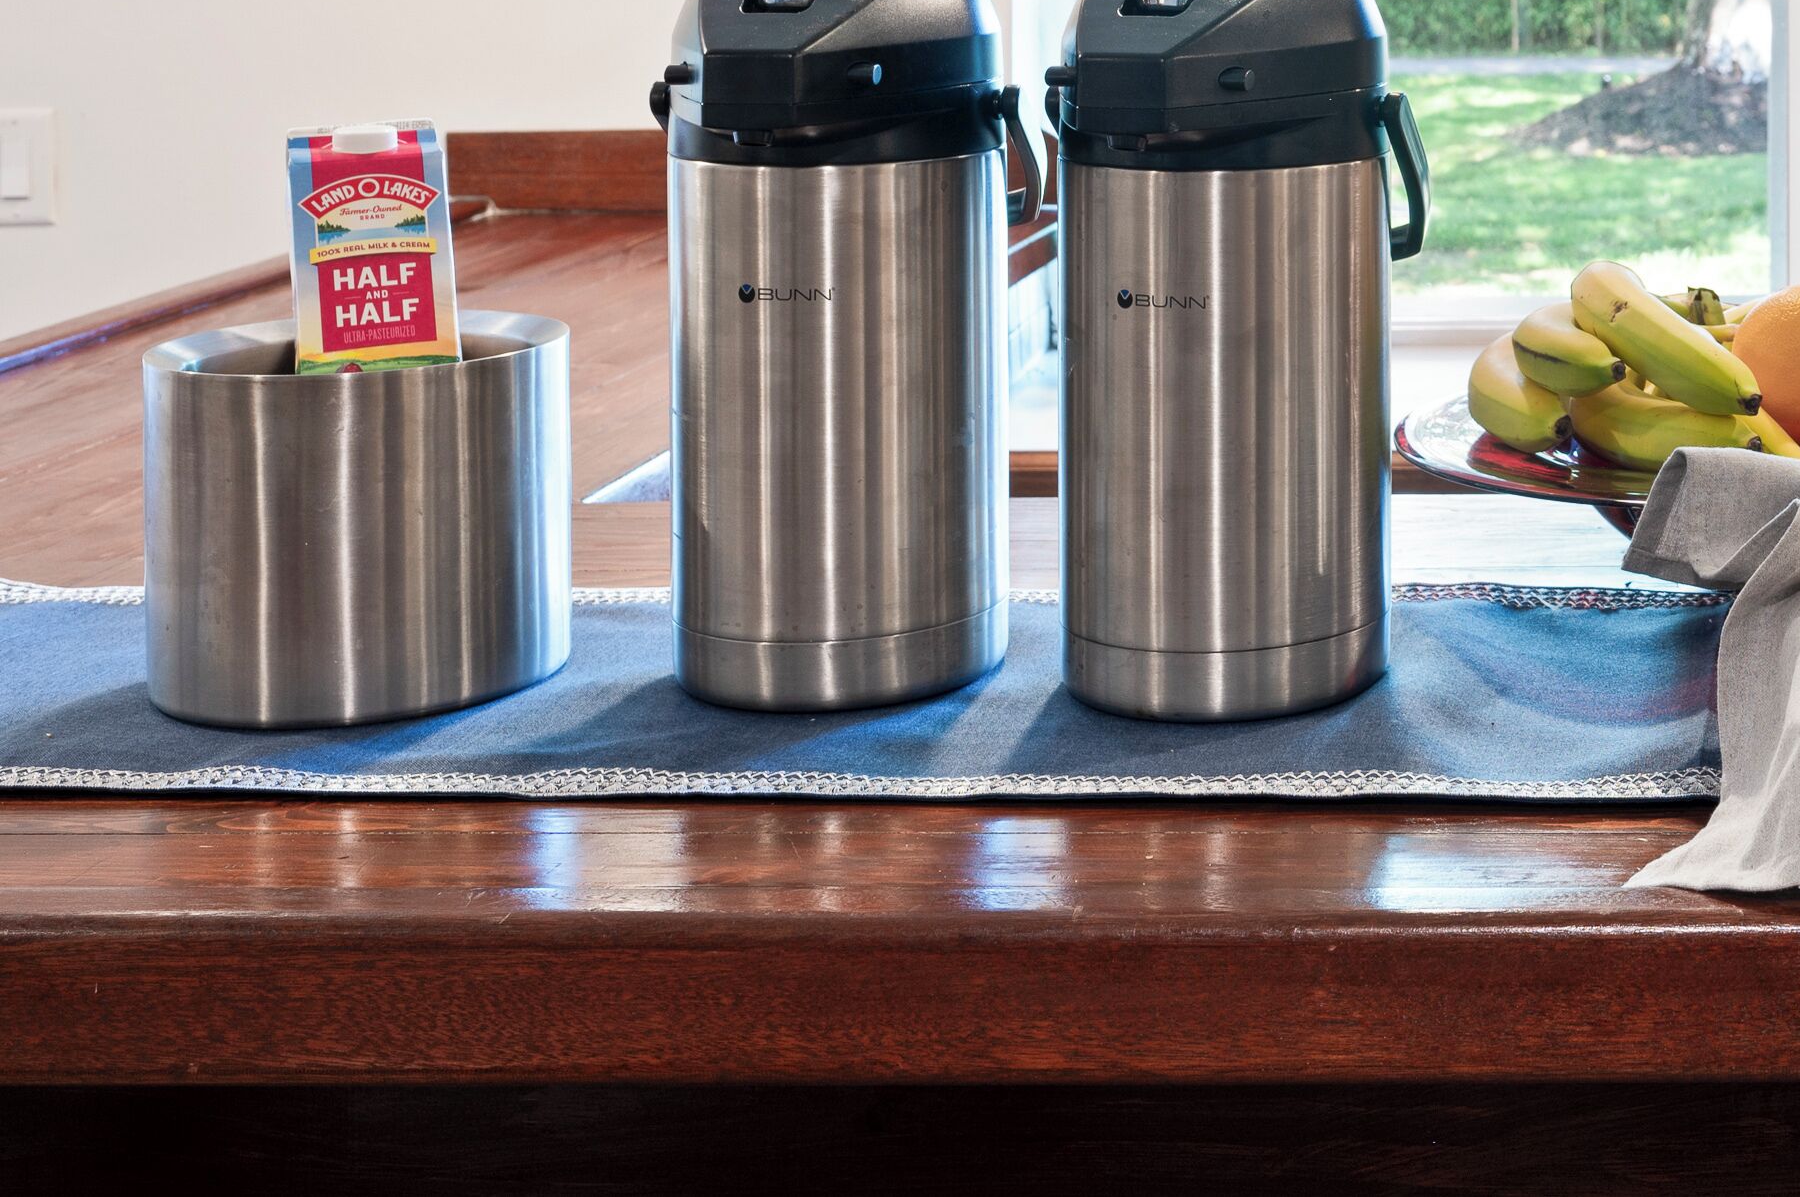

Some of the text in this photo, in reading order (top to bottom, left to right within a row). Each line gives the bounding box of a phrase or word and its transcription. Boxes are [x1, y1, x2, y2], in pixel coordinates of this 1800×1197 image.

[311, 178, 430, 212] LAND O LAKES
[339, 204, 403, 216] Farmer-Owned
[317, 248, 340, 258] 100%
[343, 244, 366, 253] REAL
[368, 242, 390, 250] MILK
[400, 240, 431, 249] CREAM
[333, 262, 417, 291] HALF
[366, 290, 388, 300] AND
[757, 288, 832, 302] BUNN
[1134, 294, 1205, 309] BUNN
[336, 298, 420, 328] HALF
[344, 325, 416, 344] ULTRA-PASTEURIZED
